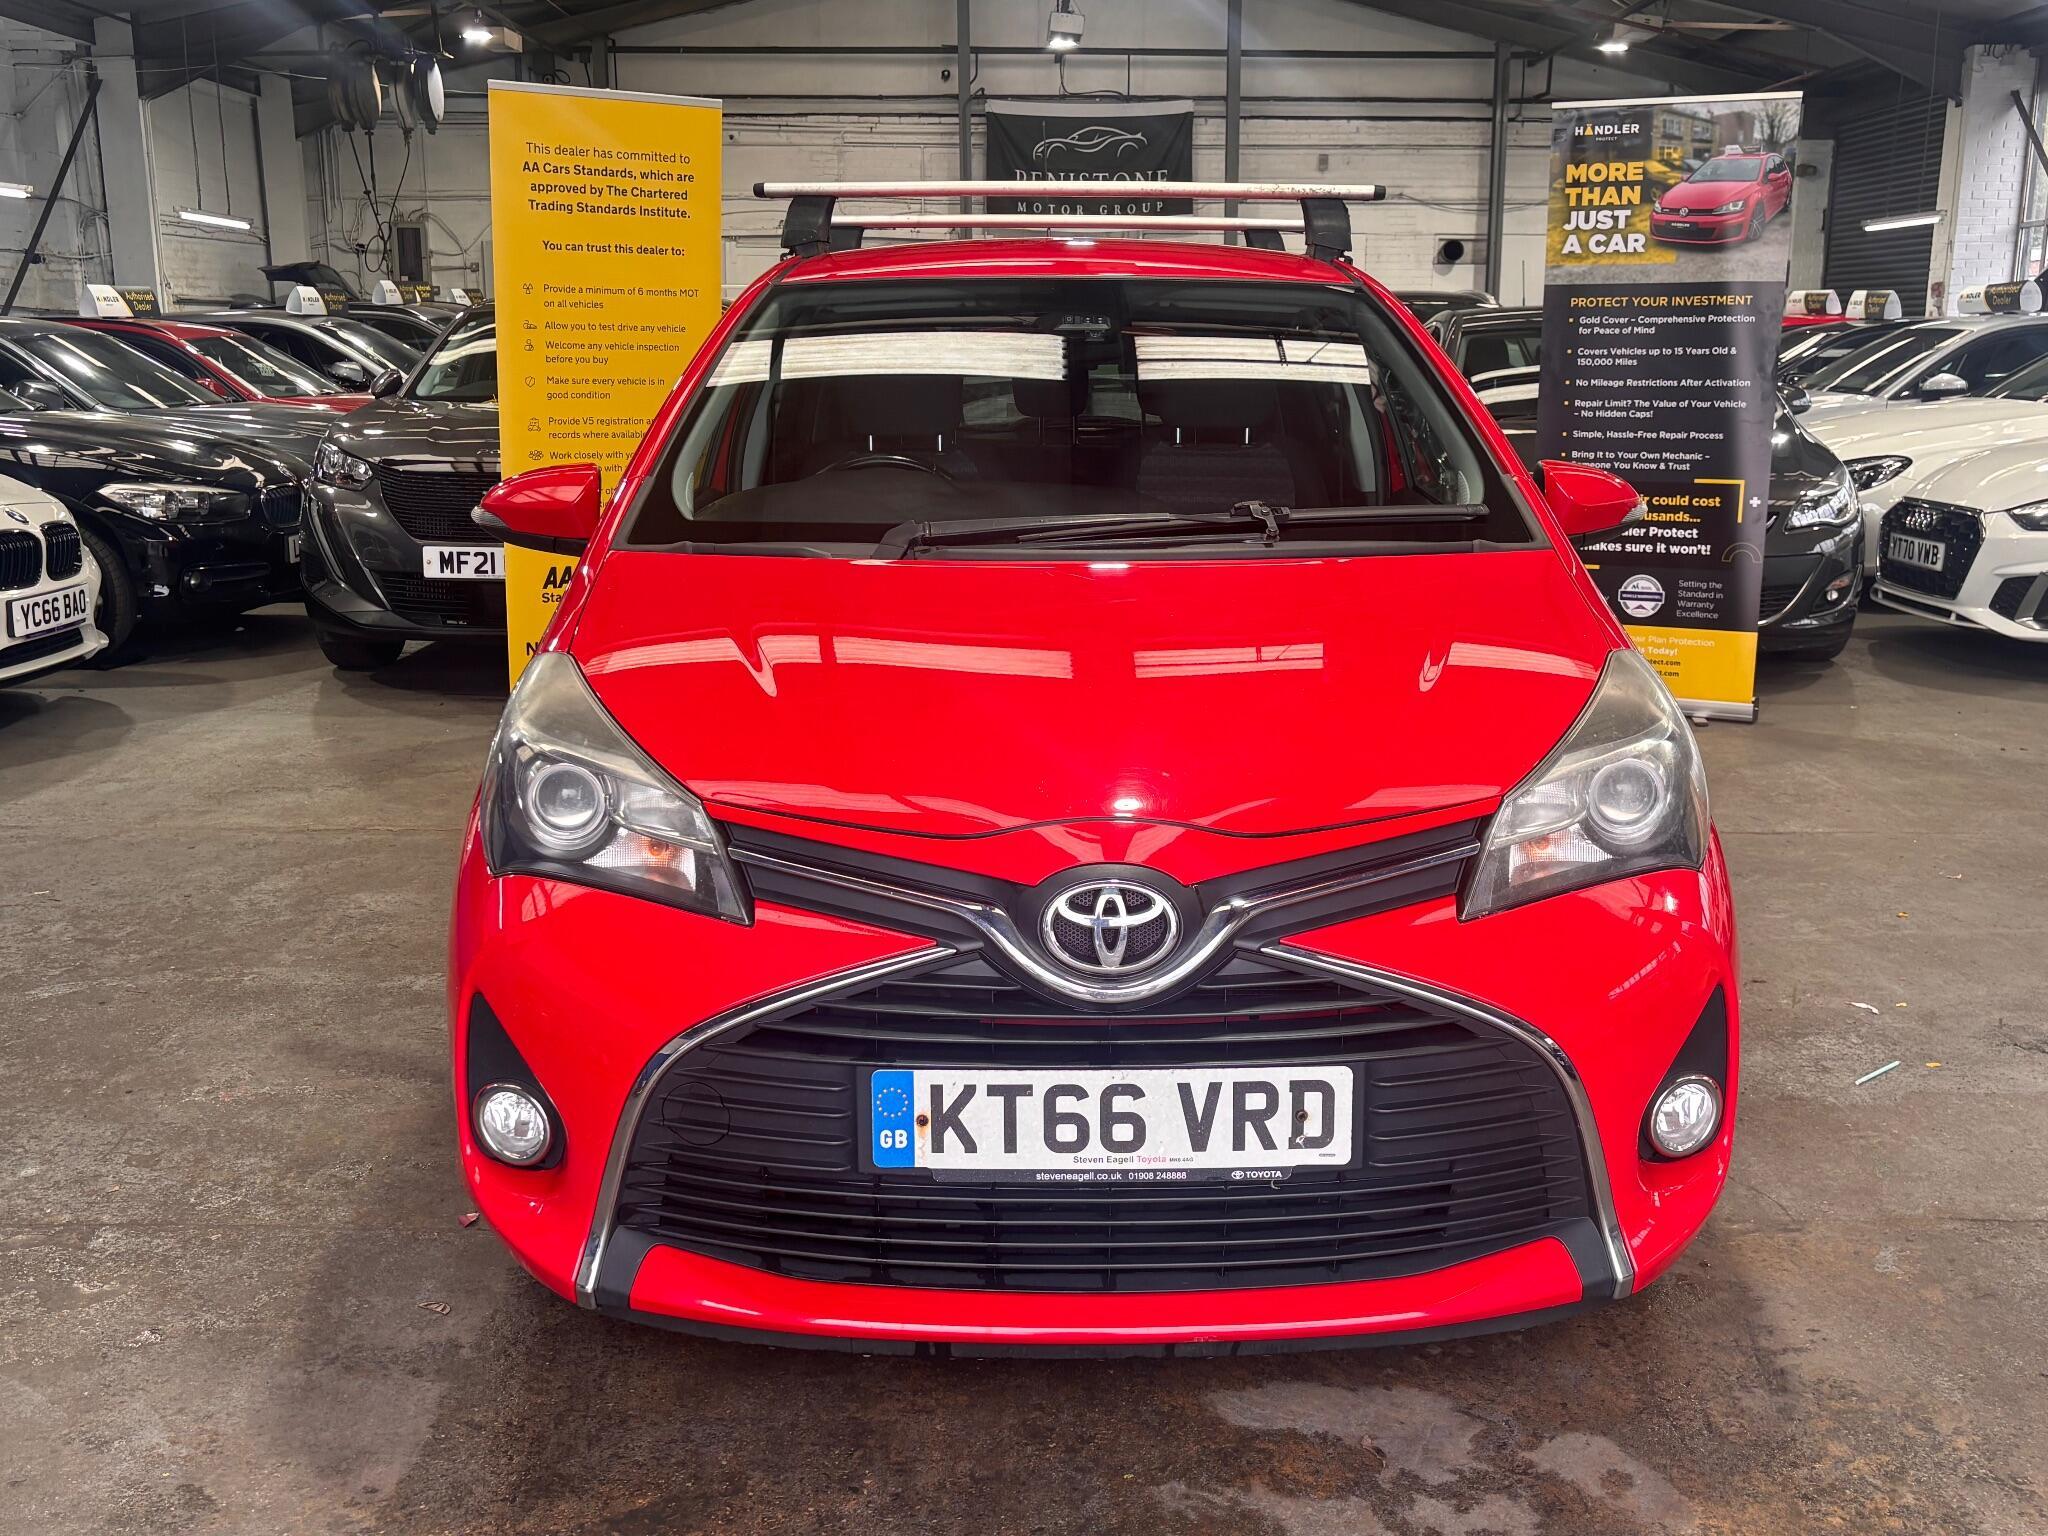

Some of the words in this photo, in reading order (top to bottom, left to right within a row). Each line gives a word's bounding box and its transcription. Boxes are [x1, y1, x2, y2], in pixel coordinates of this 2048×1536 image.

[526, 142, 550, 154] This
[554, 144, 590, 157] dealer
[593, 146, 613, 159] has
[616, 149, 676, 163] committed
[679, 153, 691, 164] to
[522, 161, 540, 173] AA
[543, 162, 570, 175] Cars
[573, 165, 637, 180] Standards,
[639, 169, 673, 181] which
[676, 172, 695, 183] are
[1566, 161, 1644, 183] MORE
[530, 182, 586, 195] approved
[590, 184, 603, 197] by
[606, 185, 628, 197] The
[630, 186, 688, 200] Chartered
[1564, 185, 1641, 207] THAN
[528, 199, 573, 214] Trading
[576, 202, 636, 216] Standards
[639, 205, 691, 219] Institute.
[1017, 201, 1084, 215] MOTOR
[1099, 201, 1164, 215] GROUP
[1562, 209, 1631, 231] JUST
[542, 240, 562, 251] You
[565, 242, 583, 252] can
[586, 242, 611, 253] trust
[614, 243, 634, 254] this
[636, 244, 668, 256] dealer
[671, 246, 685, 257] to:
[1561, 234, 1582, 254] A
[1588, 233, 1646, 254] CAR
[543, 283, 576, 294] Provide
[585, 285, 625, 295] minimum
[646, 287, 677, 297] months
[679, 288, 700, 298] MOT
[133, 301, 152, 311] Dealer
[543, 300, 555, 308] on
[557, 298, 568, 308] all
[569, 299, 604, 309] vehicles
[1570, 297, 1628, 308] PROTECT
[1632, 297, 1668, 307] YOUR
[1671, 295, 1753, 306] INVESTMENT
[1579, 316, 1600, 324] Gold
[1602, 316, 1629, 325] Cover
[1638, 316, 1706, 325] Comprehensive
[1708, 314, 1756, 323] Protection
[544, 321, 569, 330] Allow
[570, 323, 586, 332] you
[588, 322, 597, 331] to
[599, 323, 615, 332] test
[617, 322, 638, 332] drive
[640, 325, 655, 334] any
[656, 324, 686, 333] vehicle
[1578, 326, 1591, 335] for
[1593, 326, 1620, 335] Peace
[1622, 326, 1631, 335] of
[1633, 326, 1656, 335] Mind
[545, 340, 586, 350] Welcome
[587, 342, 602, 351] any
[604, 341, 634, 351] vehicle
[636, 342, 680, 353] inspection
[1577, 348, 1608, 356] Covers
[1610, 347, 1647, 356] Vehicles
[1649, 348, 1660, 357] up
[1674, 347, 1683, 355] 15
[1685, 347, 1710, 355] Years
[1711, 346, 1728, 355] Old
[545, 355, 573, 363] before
[575, 356, 590, 365] you
[592, 355, 609, 365] buy
[1577, 358, 1613, 367] 150,000
[1615, 358, 1638, 366] Miles
[546, 376, 569, 385] Make
[592, 378, 615, 387] every
[616, 377, 647, 386] vehicle
[1575, 379, 1588, 387] No
[1590, 378, 1624, 388] Mileage
[1626, 378, 1678, 387] Restrictions
[1680, 378, 1702, 387] After
[1704, 378, 1751, 387] Activation
[546, 392, 568, 401] good
[571, 391, 611, 400] condition
[1574, 400, 1603, 409] Repair
[1605, 400, 1632, 408] Limit?
[1634, 400, 1650, 408] The
[1652, 399, 1677, 408] Value
[1679, 400, 1688, 408] of
[1690, 400, 1712, 409] Your
[1713, 400, 1747, 409] Vehicle
[1581, 410, 1594, 418] No
[1596, 410, 1627, 418] Hidden
[1629, 410, 1654, 419] Caps!
[548, 416, 581, 426] Provide
[582, 416, 594, 425] V5
[596, 416, 644, 427] registration
[548, 431, 581, 439] records
[583, 431, 609, 439] where
[1572, 430, 1605, 439] Simple,
[1606, 430, 1657, 439] Hassle-Free
[1659, 431, 1687, 440] Repair
[1689, 431, 1724, 440] Process
[550, 451, 572, 460] Work
[574, 451, 604, 460] closely
[605, 451, 624, 459] with
[1571, 450, 1595, 460] Bring
[1605, 451, 1615, 459] to
[1617, 451, 1638, 459] Your
[1640, 451, 1660, 460] Own
[1662, 452, 1703, 461] Mechanic
[605, 464, 623, 472] with
[1613, 461, 1631, 470] You
[1633, 462, 1658, 470] Know
[1668, 462, 1691, 471] Trust
[1652, 495, 1689, 506] could
[1692, 497, 1721, 507] cost
[1649, 527, 1699, 539] Protect
[1624, 543, 1653, 553] sure
[1656, 542, 1666, 553] it
[1669, 544, 1711, 555] won't!
[1917, 541, 1939, 565] VWB
[439, 550, 496, 574] MF21
[1678, 579, 1707, 589] Setting
[1709, 581, 1723, 589] the
[1677, 590, 1714, 599] Standard
[20, 597, 60, 630] YC66
[63, 589, 86, 619] BAO
[1677, 600, 1715, 610] Warranty
[1676, 609, 1719, 620] Excellence
[1648, 635, 1667, 643] Plan
[1668, 636, 1715, 647] Protection
[1647, 646, 1678, 656] Today!
[929, 1083, 1147, 1154] KT66
[1177, 1079, 1336, 1153] VRD
[879, 1129, 908, 1149] GB
[1073, 1155, 1104, 1164] Steven
[1106, 1155, 1134, 1165] Eagell
[1136, 1155, 1167, 1165] Toyota
[1036, 1171, 1122, 1182] steveneagell.co.uk
[1128, 1171, 1154, 1181] 01908
[1156, 1170, 1187, 1180] 248888
[1245, 1170, 1283, 1179] TOYOTA
